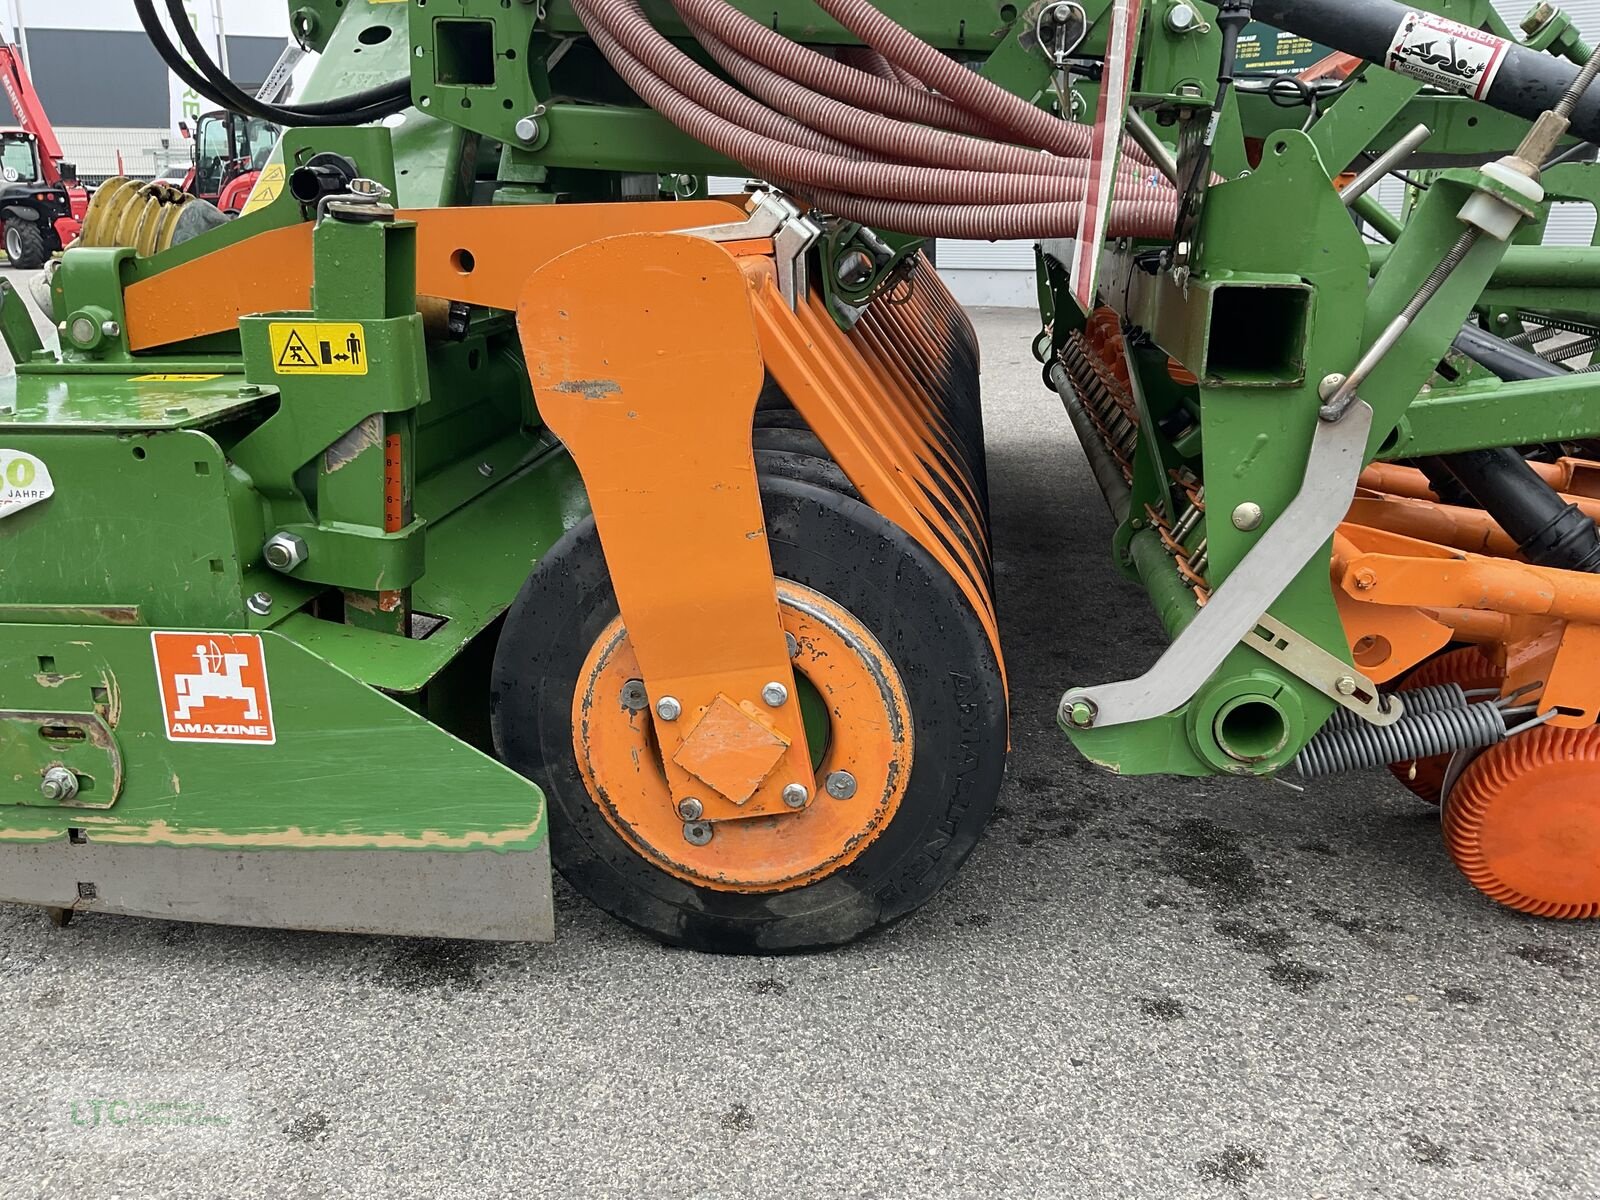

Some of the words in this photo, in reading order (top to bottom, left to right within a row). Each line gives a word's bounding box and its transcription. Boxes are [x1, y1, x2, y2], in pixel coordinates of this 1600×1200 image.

[1400, 62, 1437, 77] ROTATING
[1435, 73, 1473, 90] DRIVELINE
[2, 73, 28, 125] MANITOU
[6, 168, 16, 179] 20
[8, 490, 46, 498] JAHRE
[172, 723, 269, 736] AMAZONE
